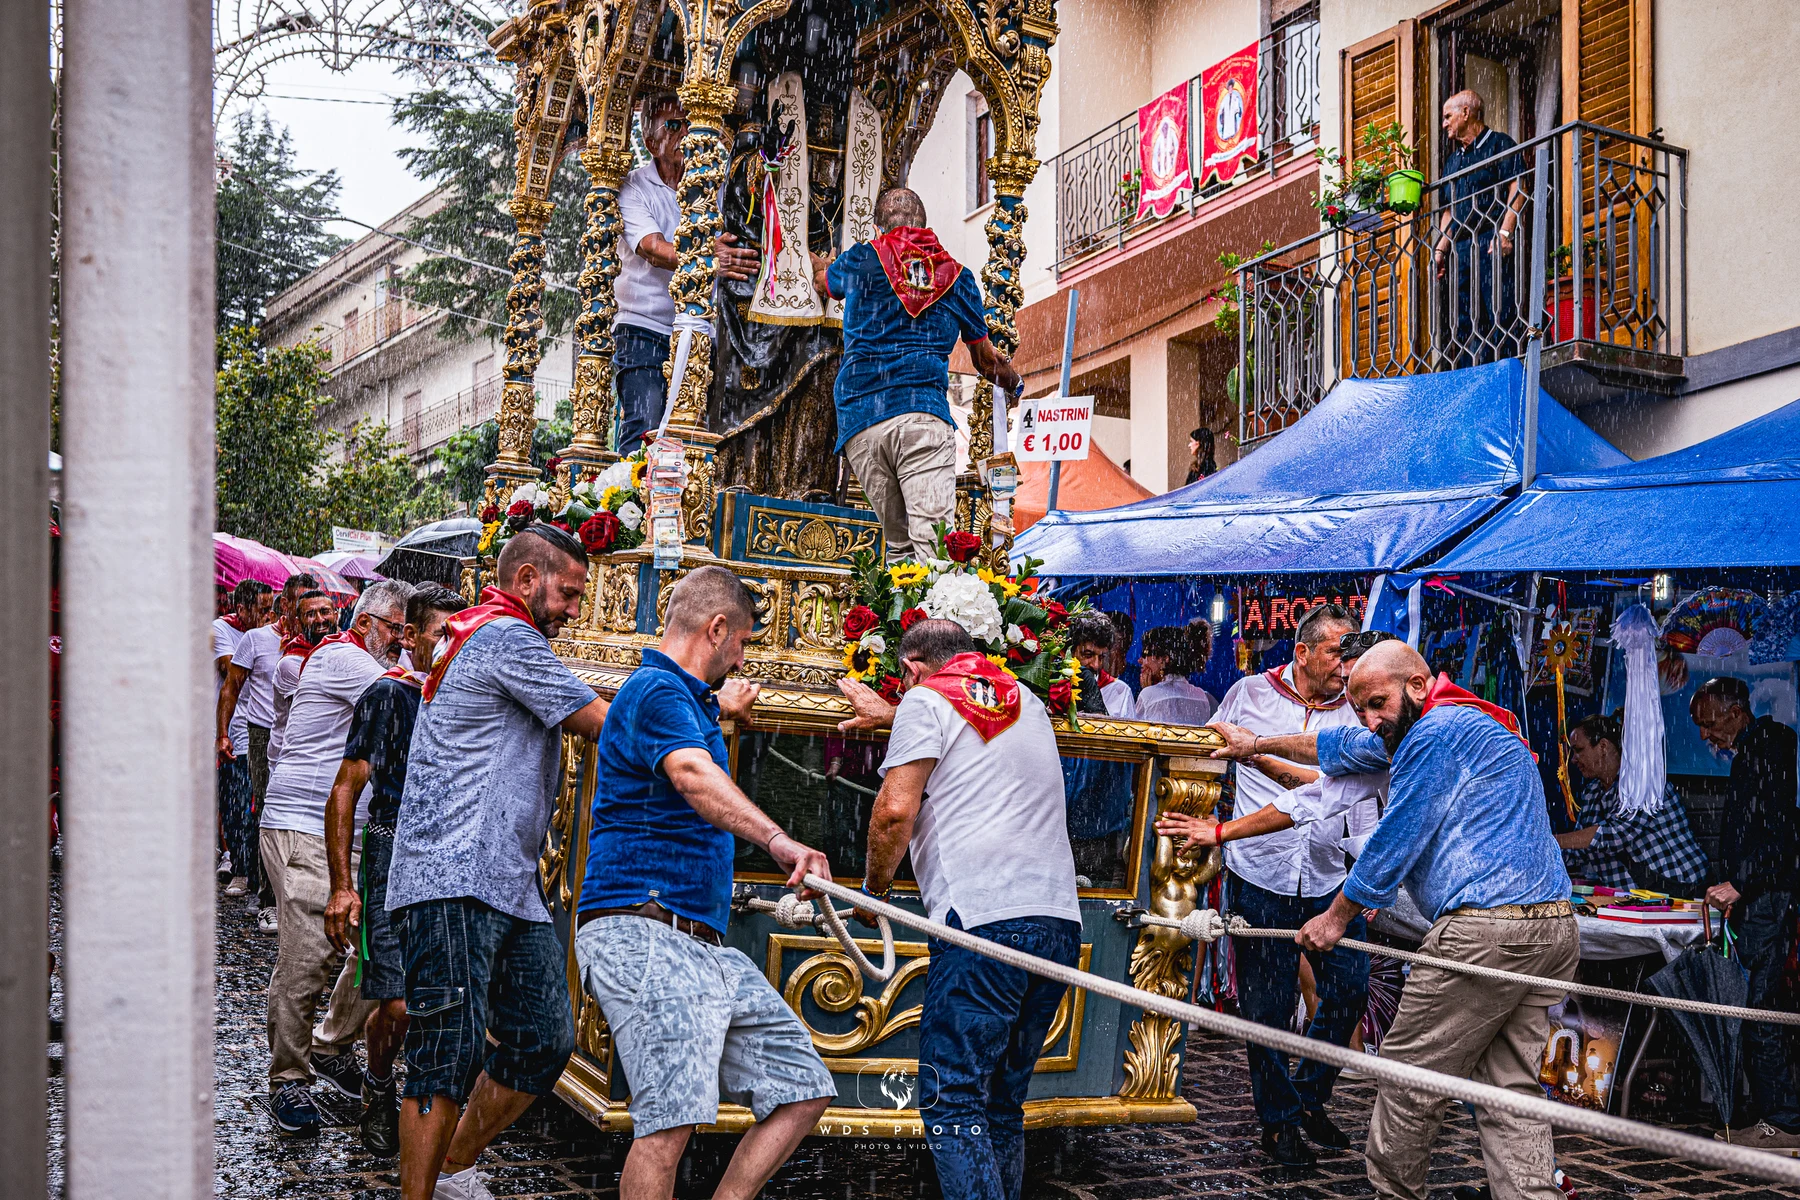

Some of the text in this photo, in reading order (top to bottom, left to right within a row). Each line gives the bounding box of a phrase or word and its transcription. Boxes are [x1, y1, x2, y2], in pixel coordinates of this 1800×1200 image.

[1022, 407, 1089, 429] 4 NASTRINI
[1023, 432, 1083, 455] € 1,00
